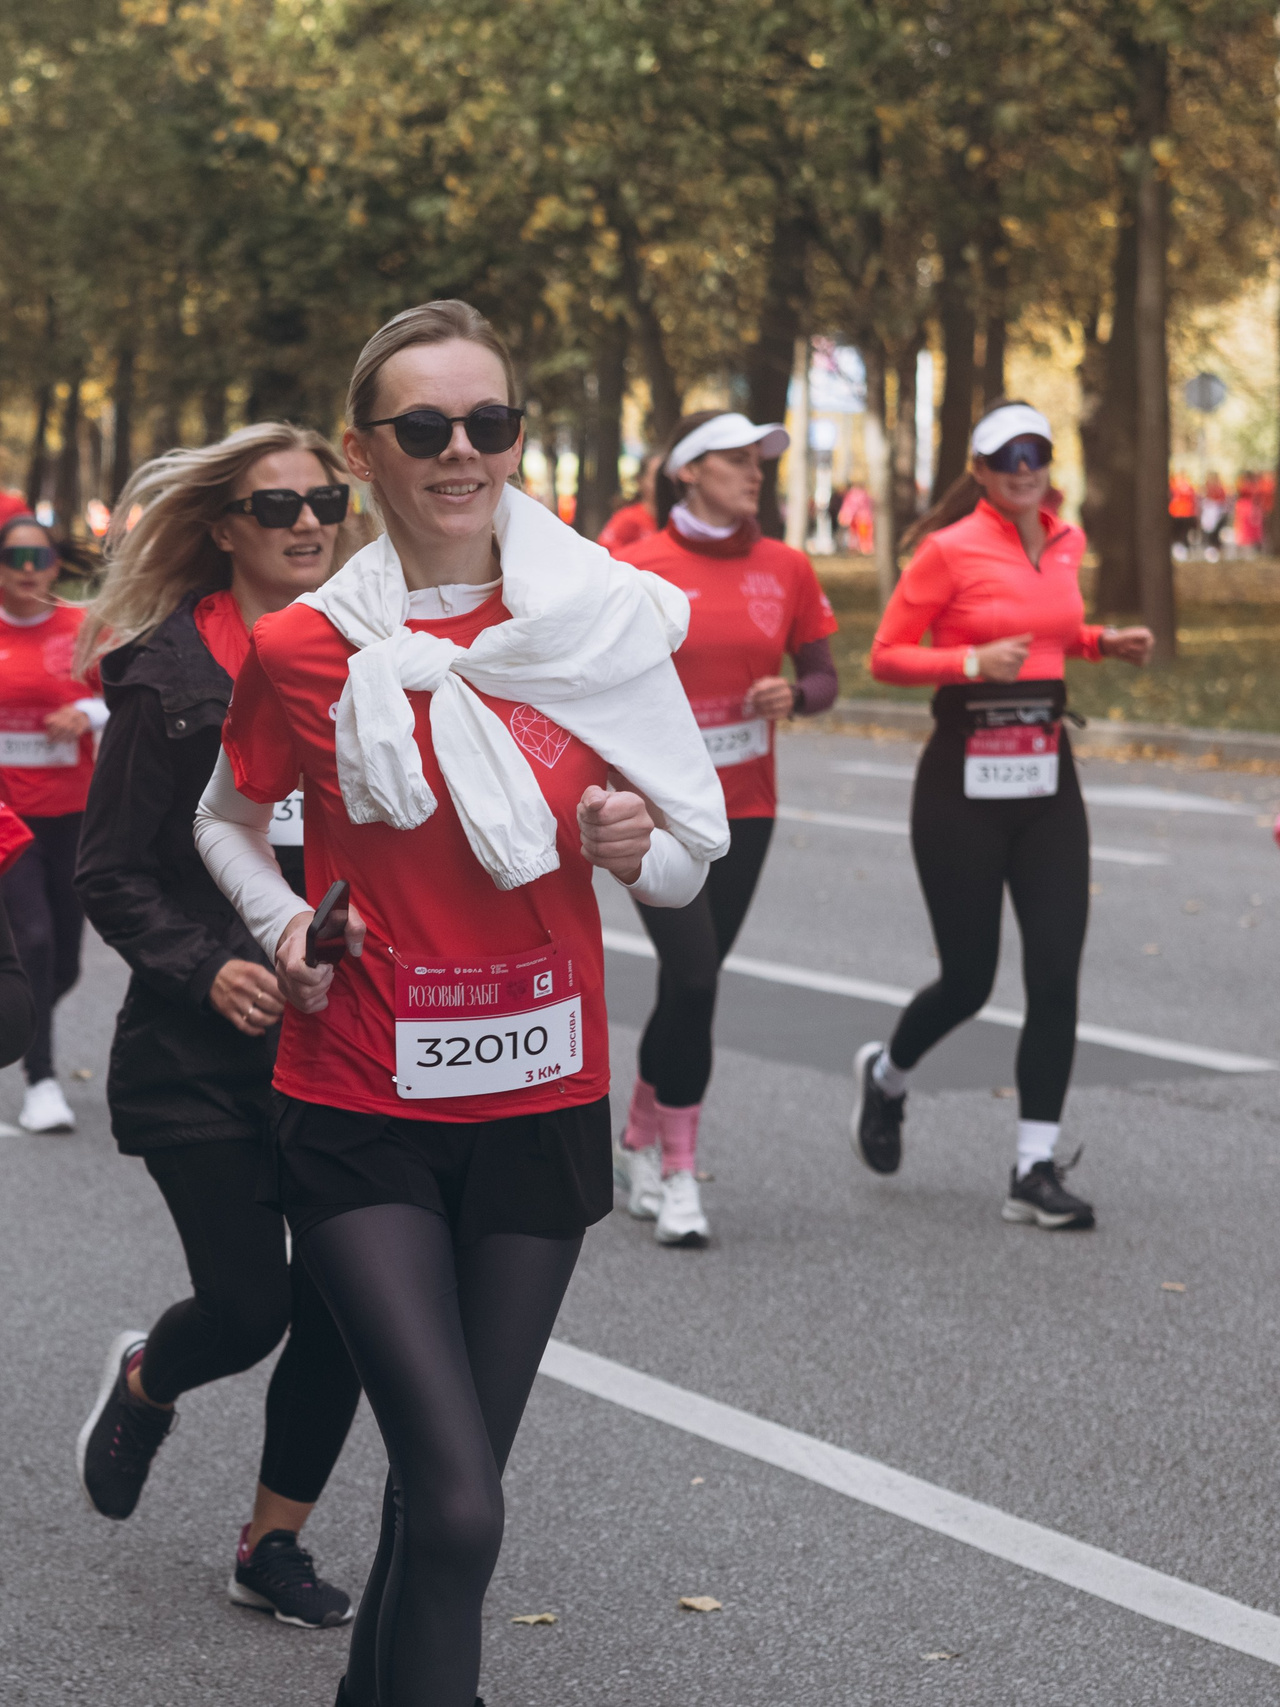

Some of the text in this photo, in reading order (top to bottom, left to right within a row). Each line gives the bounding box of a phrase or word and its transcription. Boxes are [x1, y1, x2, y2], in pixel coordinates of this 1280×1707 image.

[408, 982, 501, 1007] РОЗОВЫЙ ЗАБЕГ
[416, 1026, 548, 1068] 32010
[525, 1070, 534, 1083] 3
